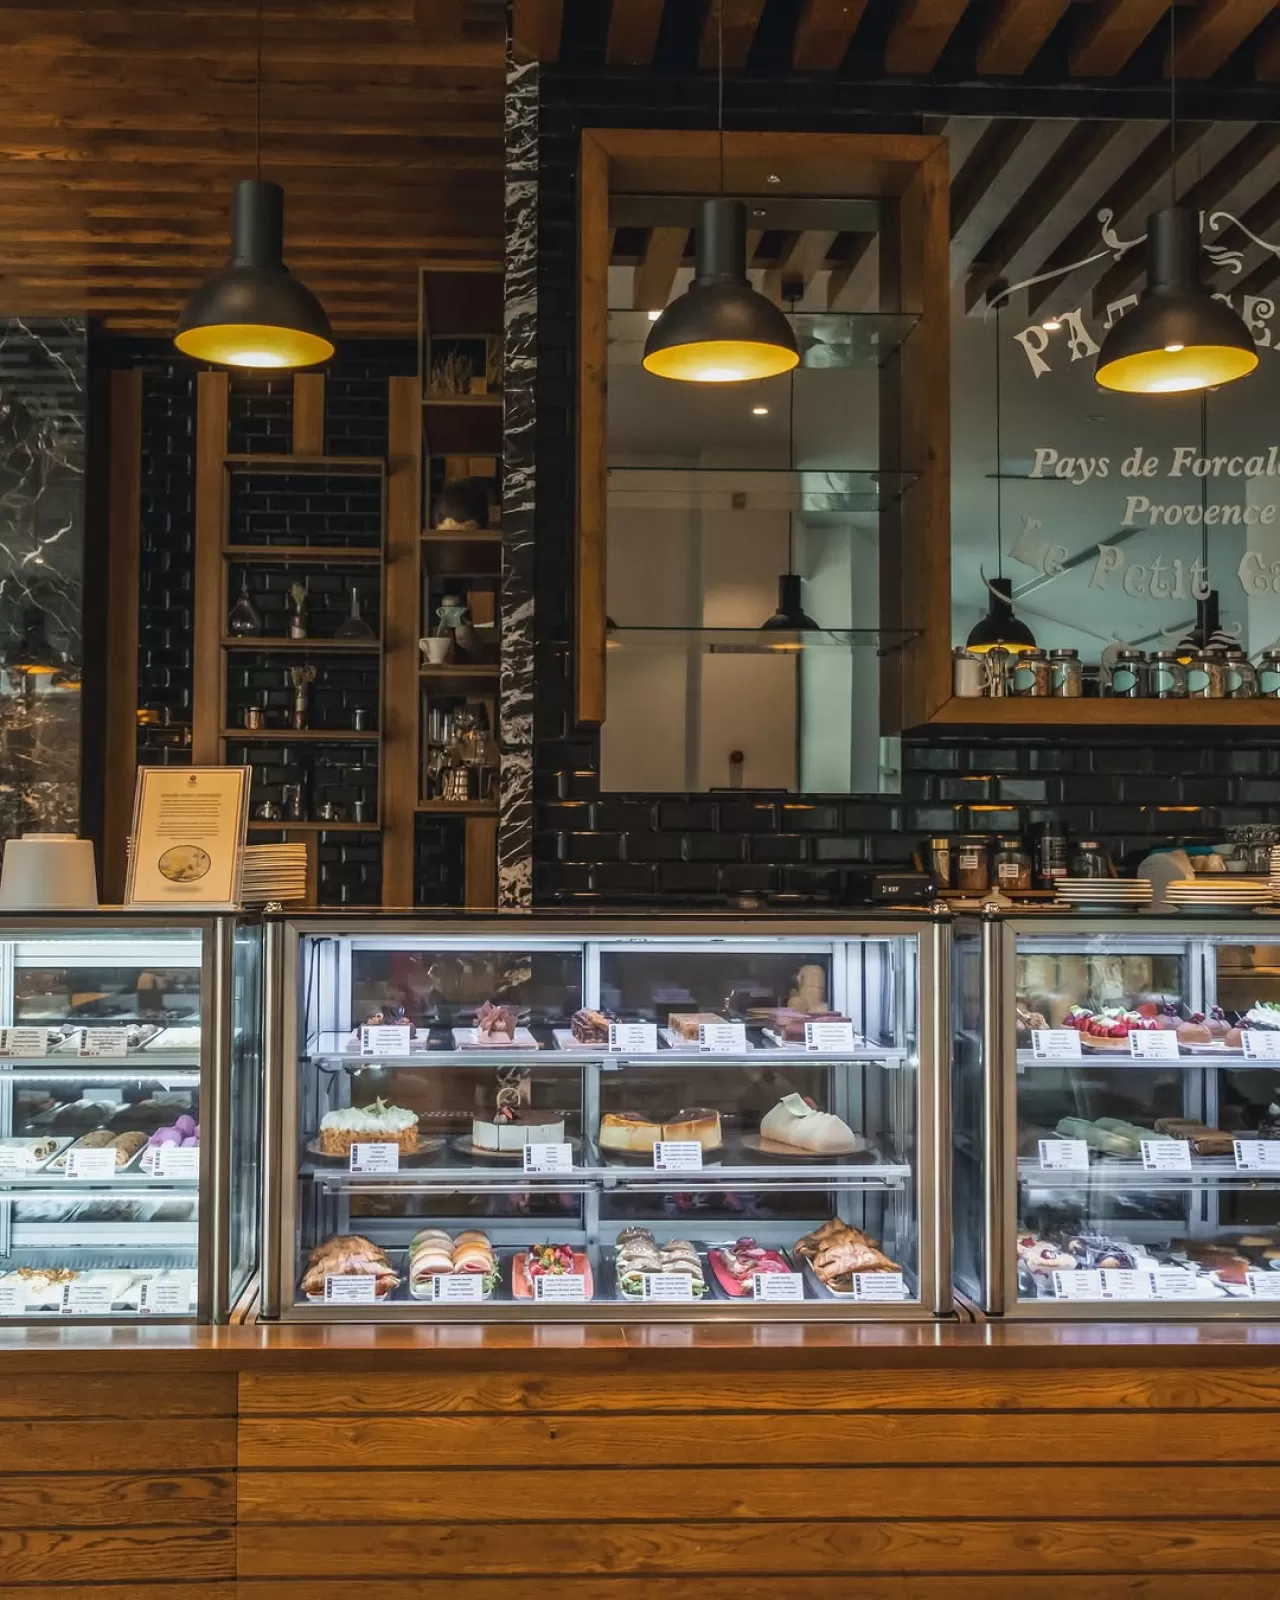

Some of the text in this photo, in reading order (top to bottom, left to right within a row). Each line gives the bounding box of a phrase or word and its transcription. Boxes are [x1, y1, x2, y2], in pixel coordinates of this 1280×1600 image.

[1028, 446, 1280, 485] Pays de Forcal
[1120, 496, 1276, 525] Provence
[1008, 515, 1069, 577] Le
[1088, 543, 1211, 601] Petit
